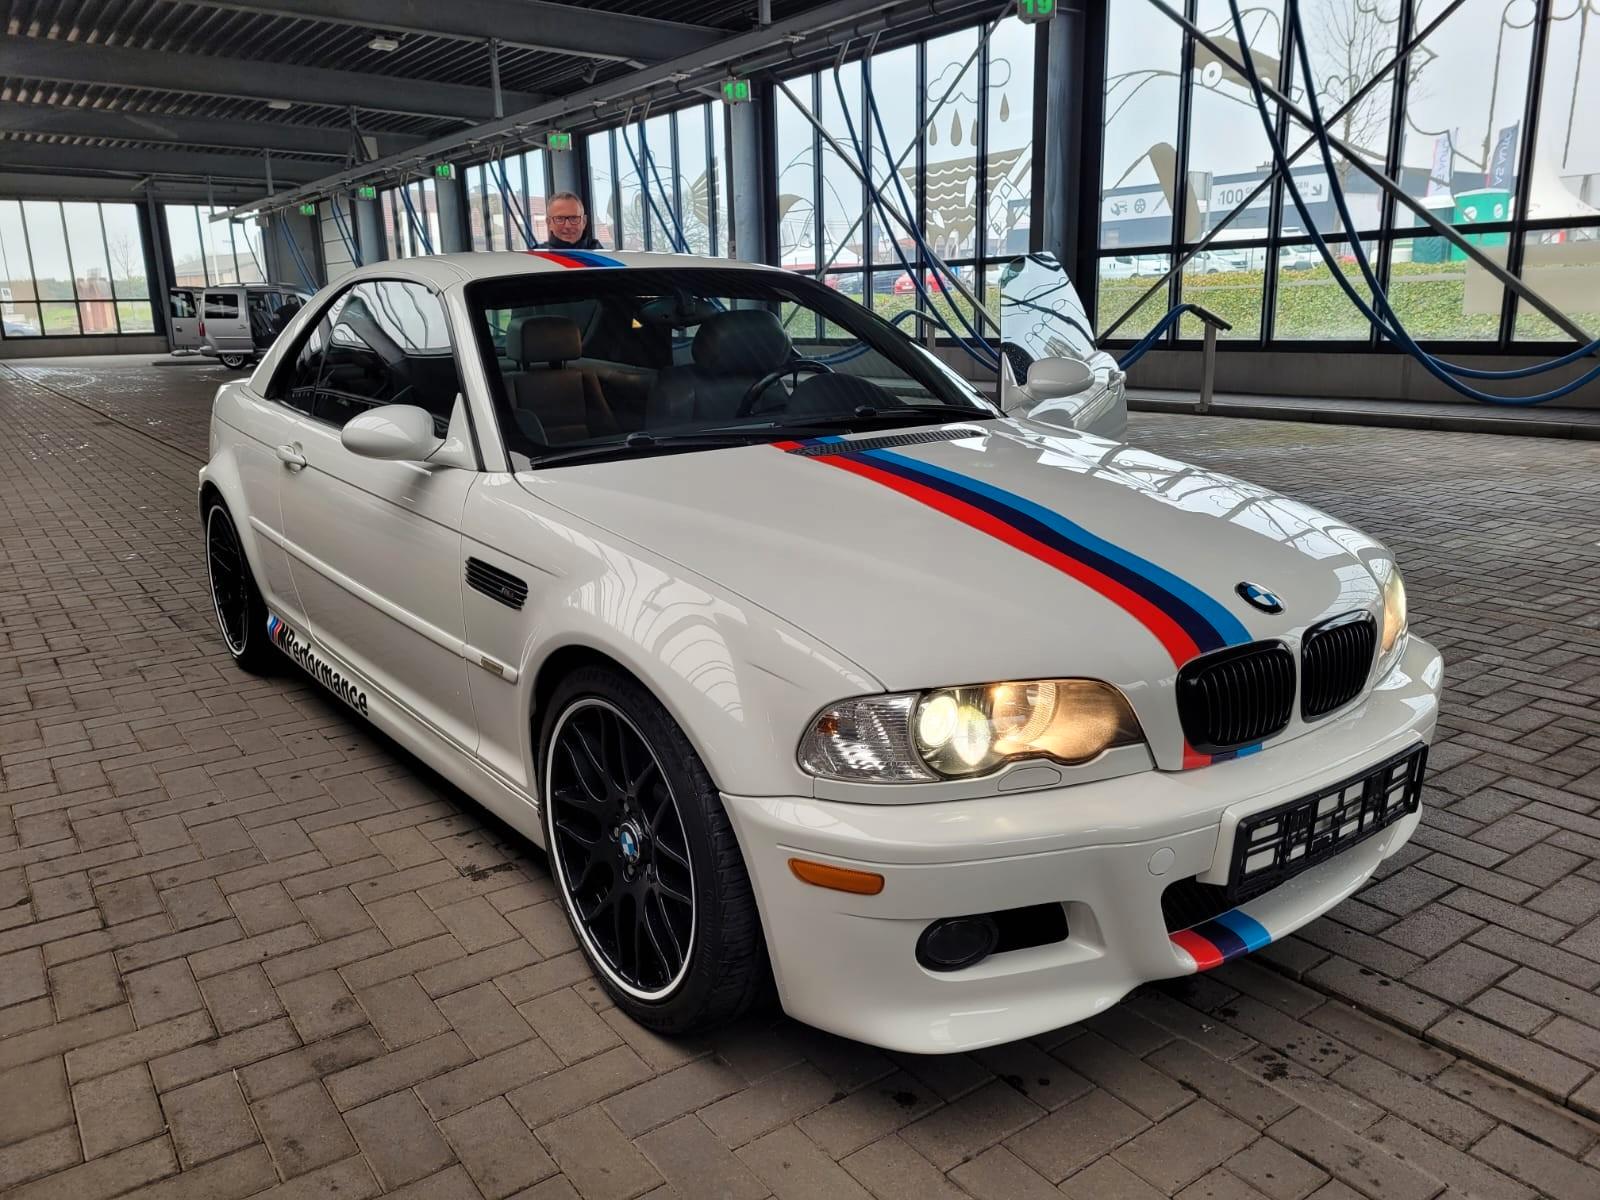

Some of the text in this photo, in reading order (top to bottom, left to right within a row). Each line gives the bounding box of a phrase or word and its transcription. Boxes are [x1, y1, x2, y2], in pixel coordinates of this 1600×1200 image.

[1021, 0, 1053, 14] 19
[723, 82, 748, 99] 18
[548, 134, 569, 149] 17
[436, 164, 449, 177] 16
